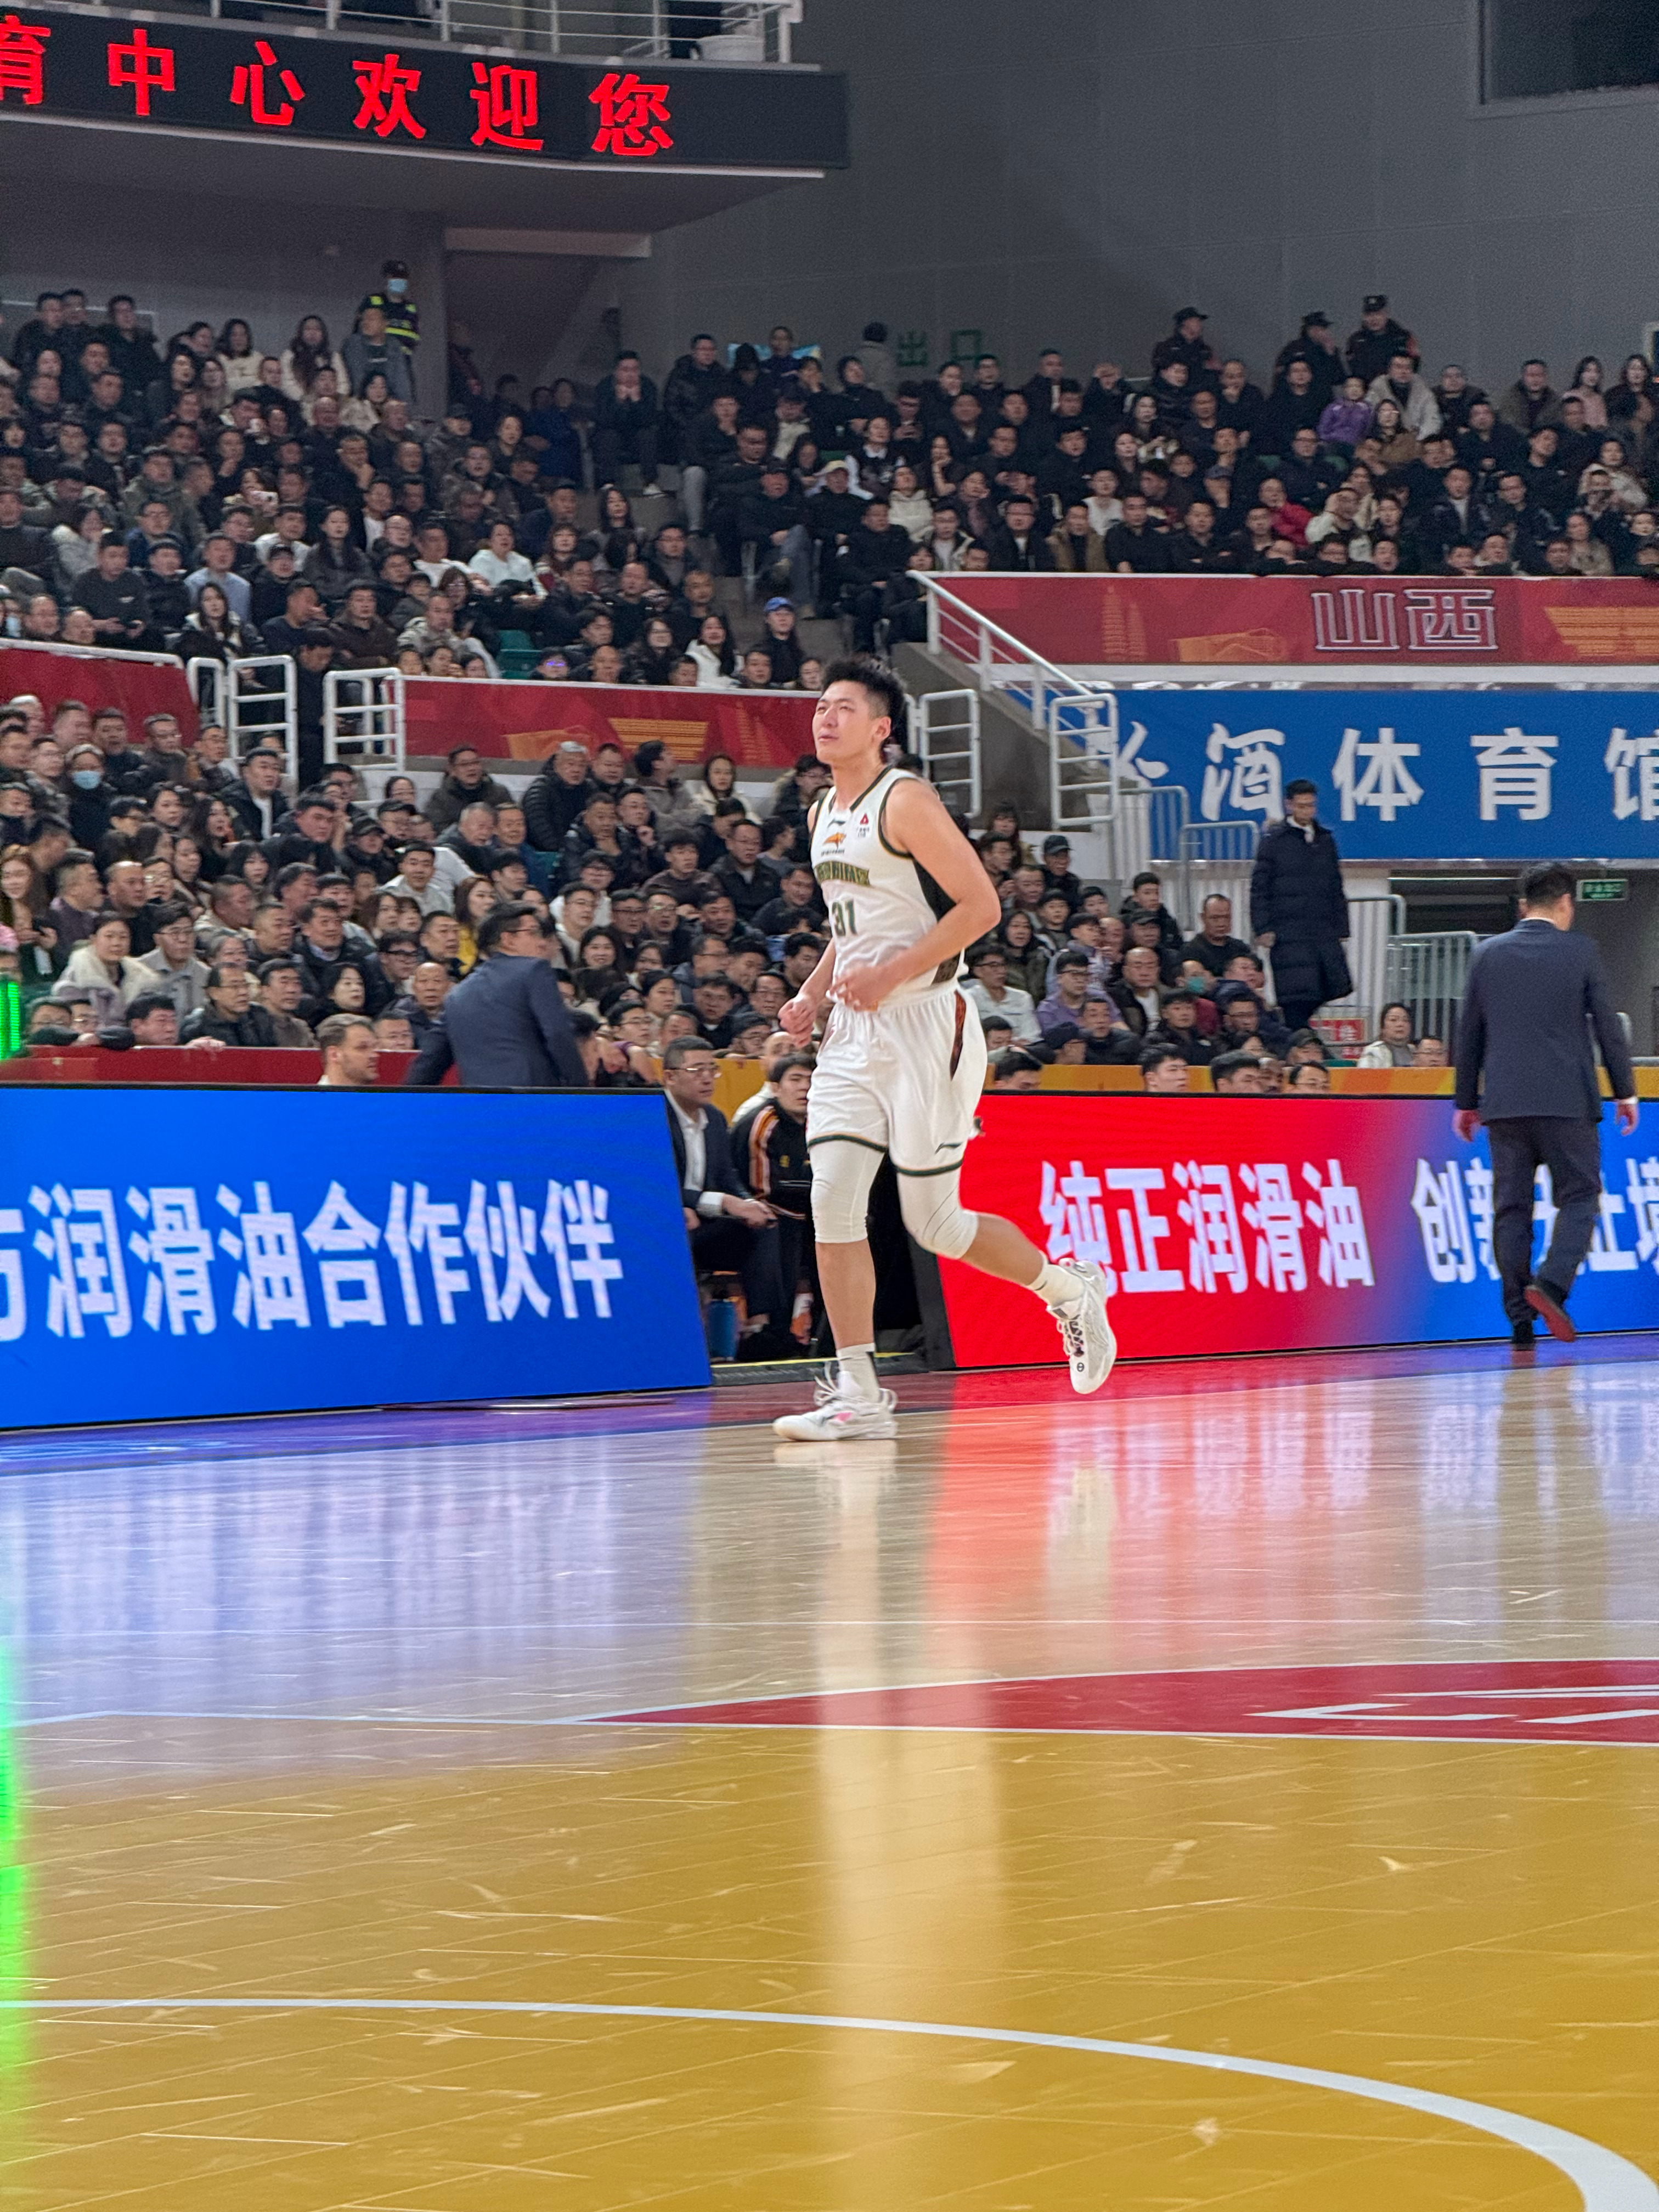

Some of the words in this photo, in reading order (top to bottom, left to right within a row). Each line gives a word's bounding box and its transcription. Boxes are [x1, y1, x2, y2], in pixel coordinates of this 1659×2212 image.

[0, 15, 673, 157] 育中心欢迎您
[897, 329, 983, 368] 出口
[1311, 589, 1499, 650] 山西
[832, 898, 857, 936] 31
[0, 1180, 623, 1342] 润滑油合作伙伴
[1039, 1159, 1375, 1298] 纯正润滑油
